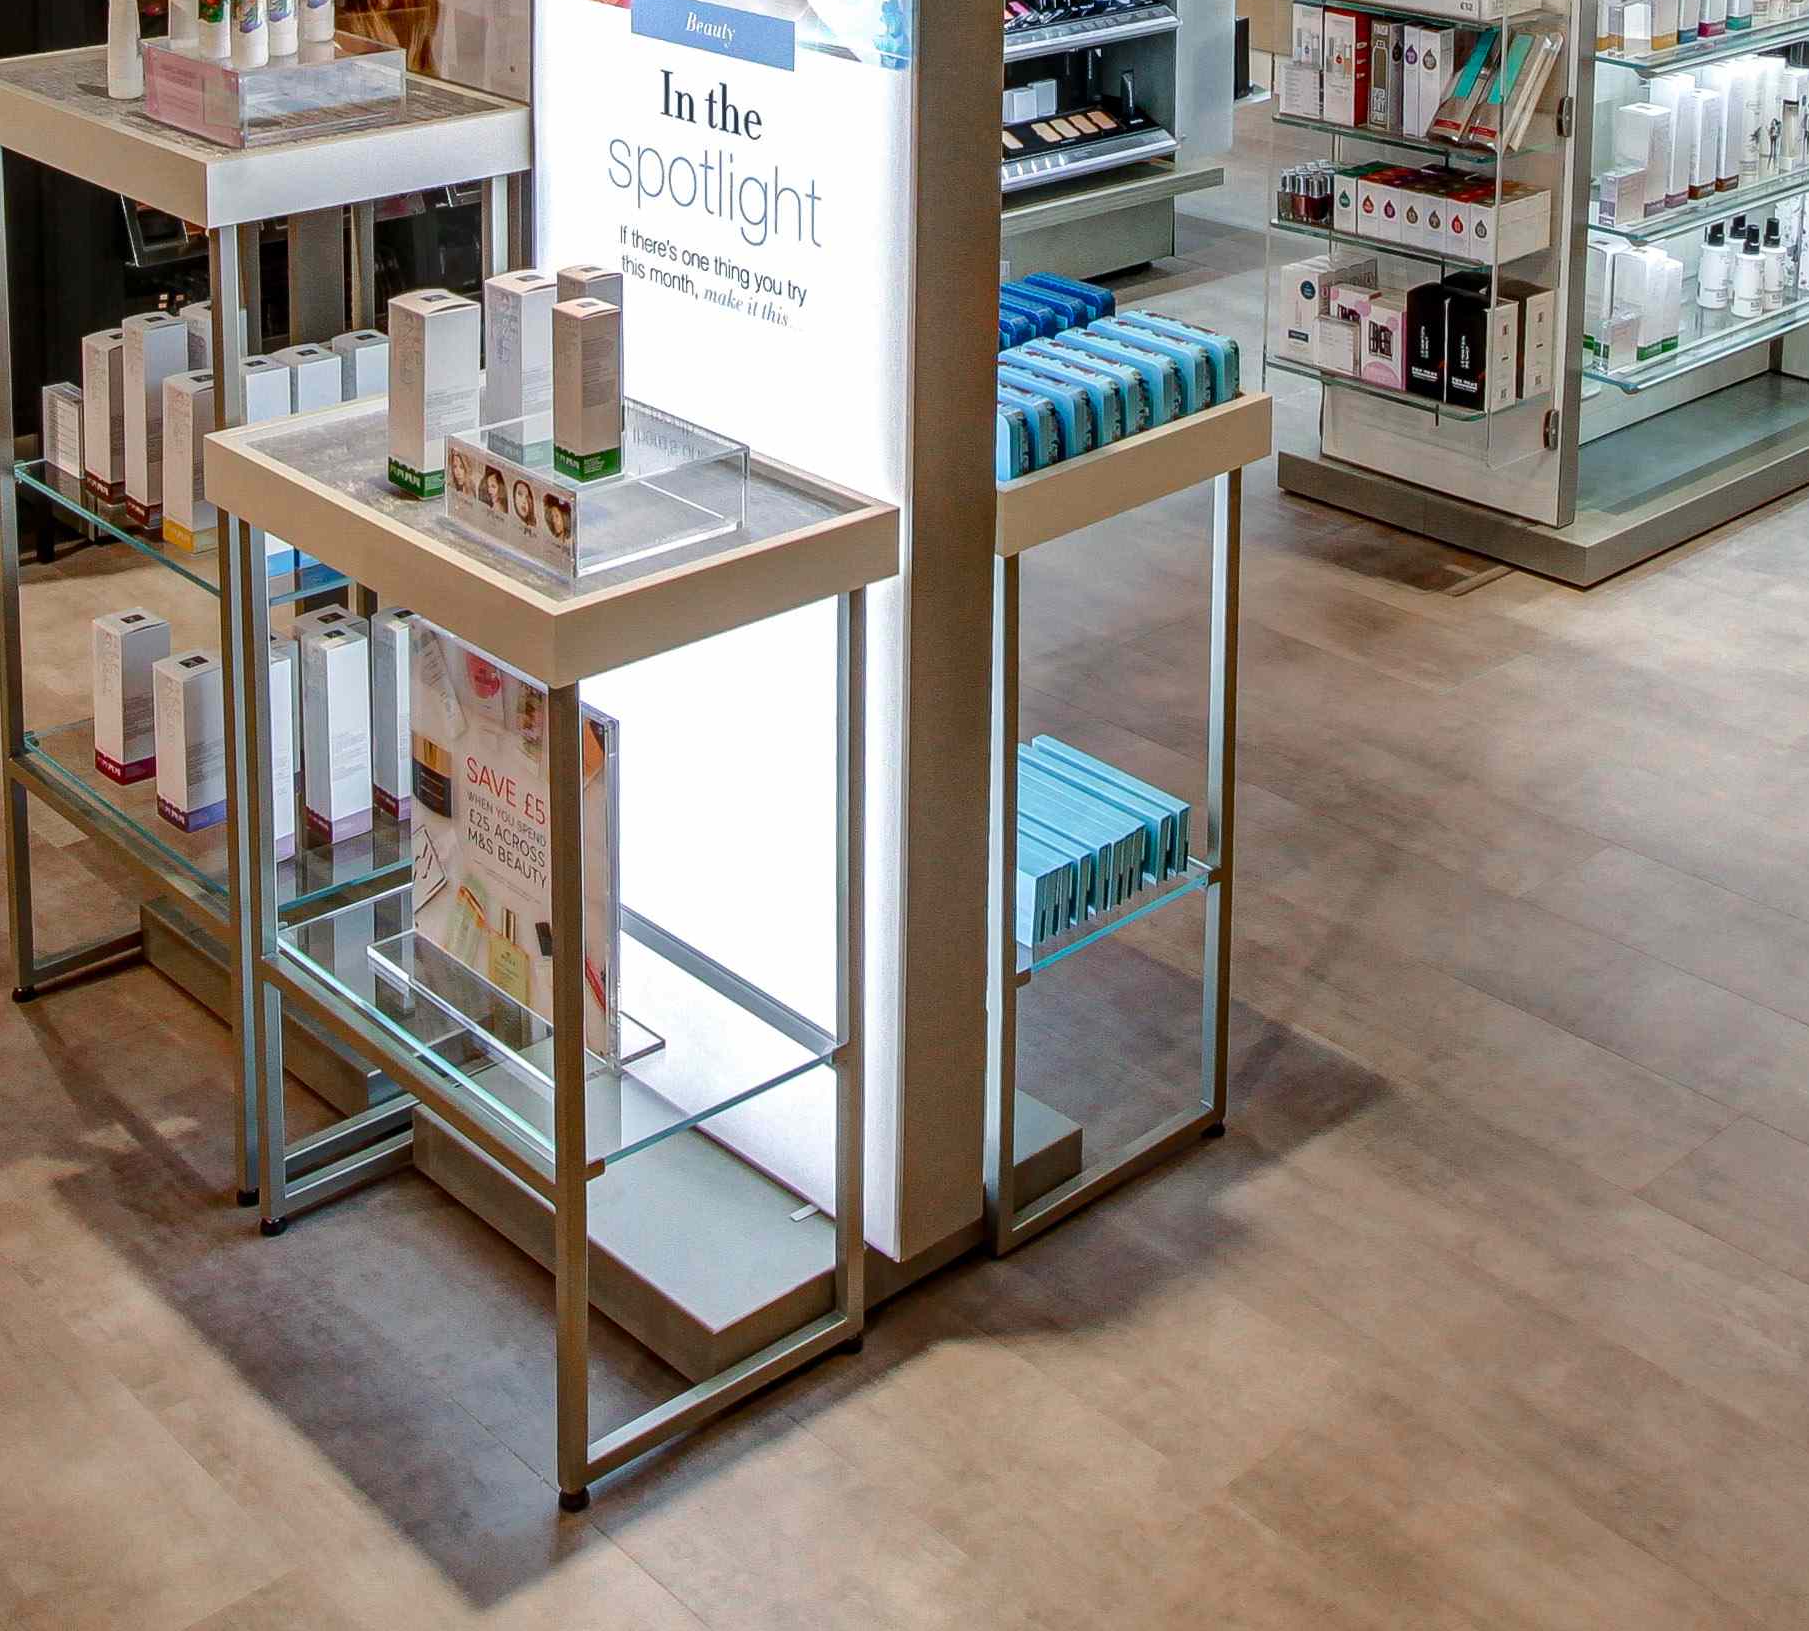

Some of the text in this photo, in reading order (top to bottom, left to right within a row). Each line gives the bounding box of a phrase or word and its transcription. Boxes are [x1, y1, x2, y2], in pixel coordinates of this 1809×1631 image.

[685, 11, 736, 48] Beauty
[660, 68, 763, 141] In the
[608, 138, 823, 248] spotlight
[620, 224, 808, 308] If there's one thing you try
[621, 254, 646, 280] this
[650, 264, 699, 300] month,
[703, 286, 744, 313] make
[747, 295, 758, 319] it
[466, 756, 546, 826] SAVE £5
[467, 791, 547, 848] WHEN YOU SPEND
[468, 827, 493, 856] M&S
[497, 845, 547, 889] BEAUTY
[469, 808, 546, 868] £25 ACROSS
